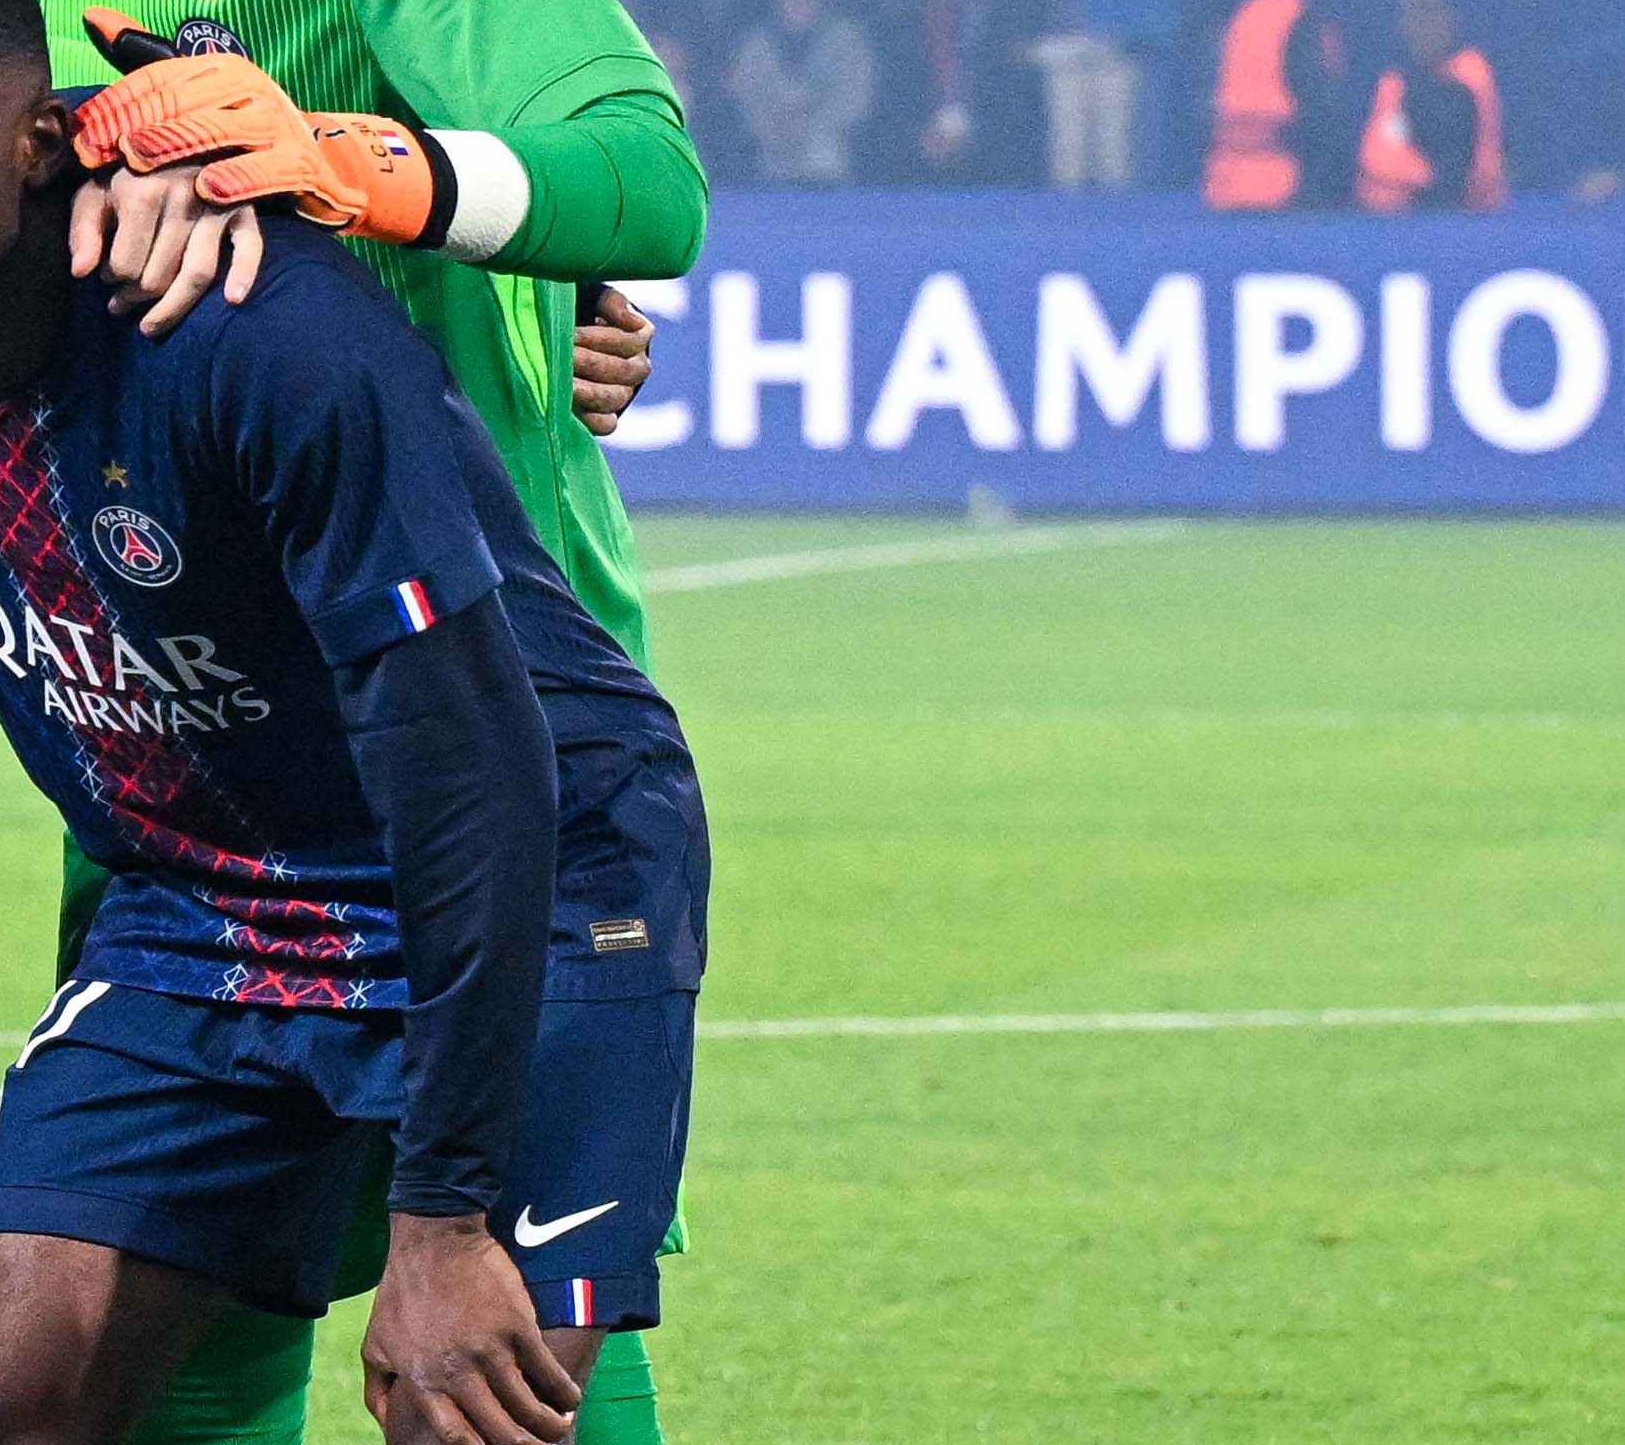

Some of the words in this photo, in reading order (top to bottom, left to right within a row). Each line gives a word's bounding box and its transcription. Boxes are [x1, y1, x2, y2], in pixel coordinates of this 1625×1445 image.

[183, 24, 232, 47] PARIS
[98, 509, 150, 531] PARIS
[43, 685, 271, 736] AIRWAYS
